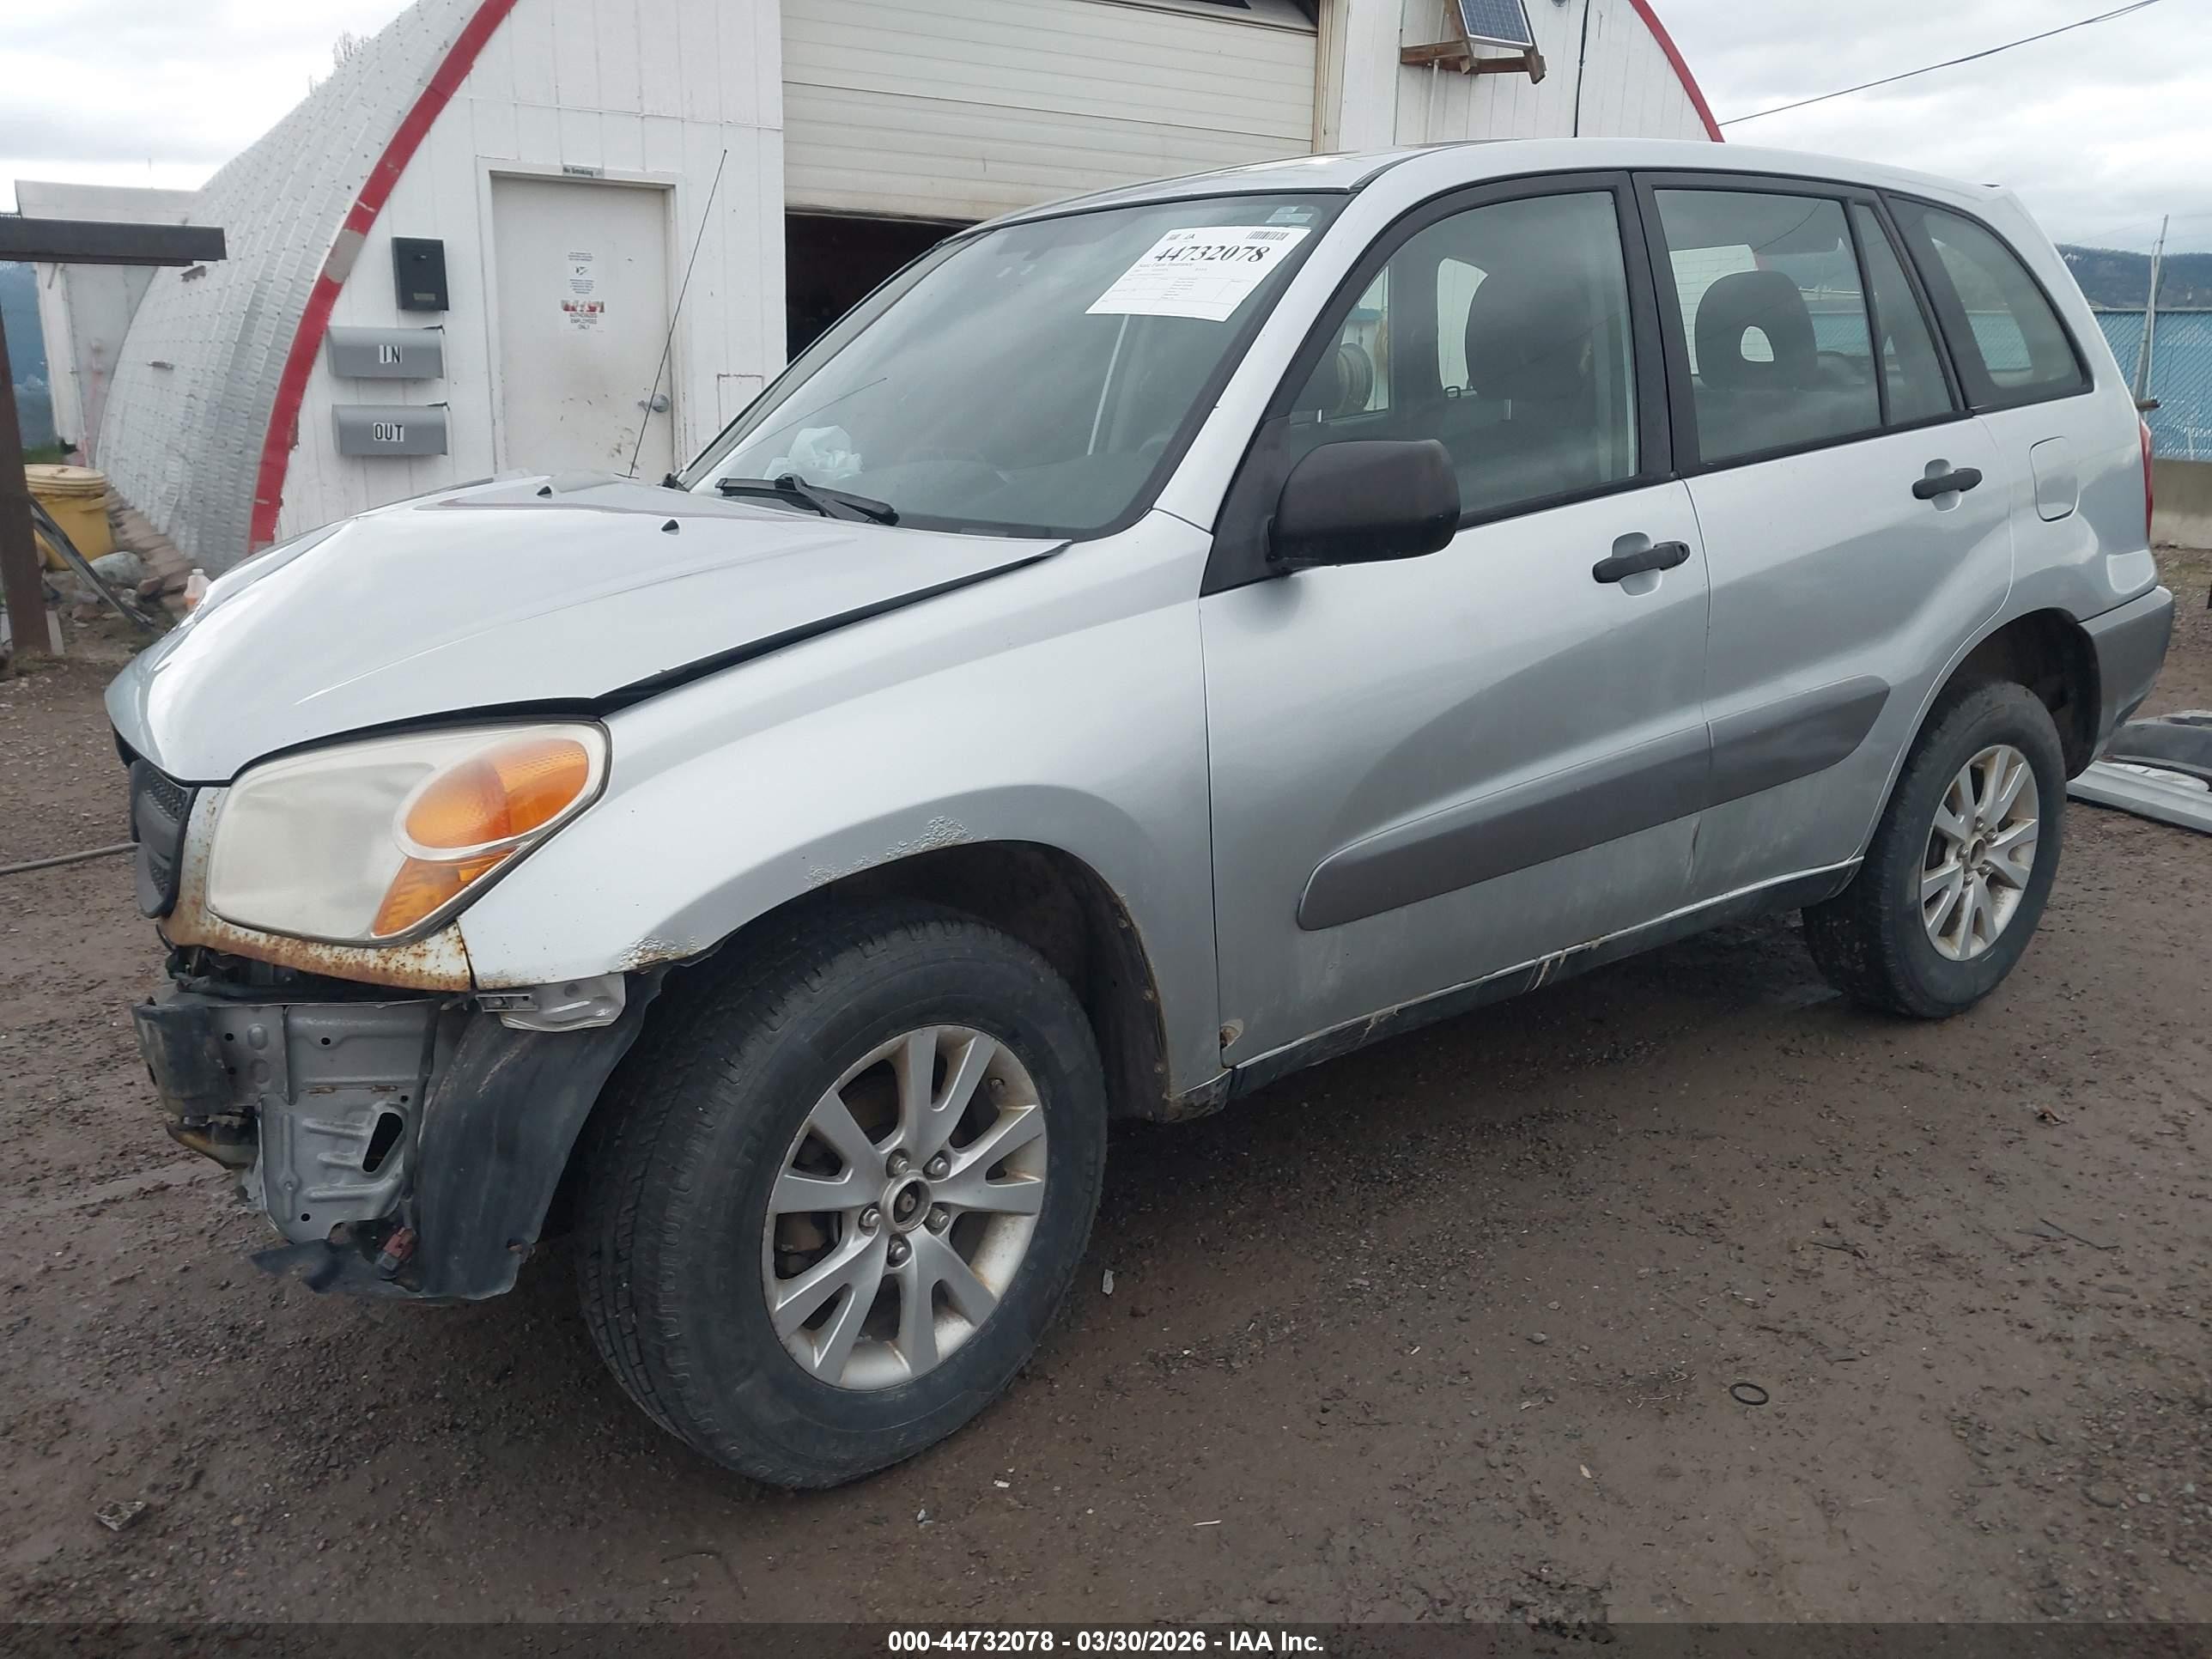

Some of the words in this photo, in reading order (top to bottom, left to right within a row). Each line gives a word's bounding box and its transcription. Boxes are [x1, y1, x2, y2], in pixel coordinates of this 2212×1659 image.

[1154, 246, 1270, 262] 44732078
[383, 346, 400, 363] IN
[374, 423, 403, 441] OUT
